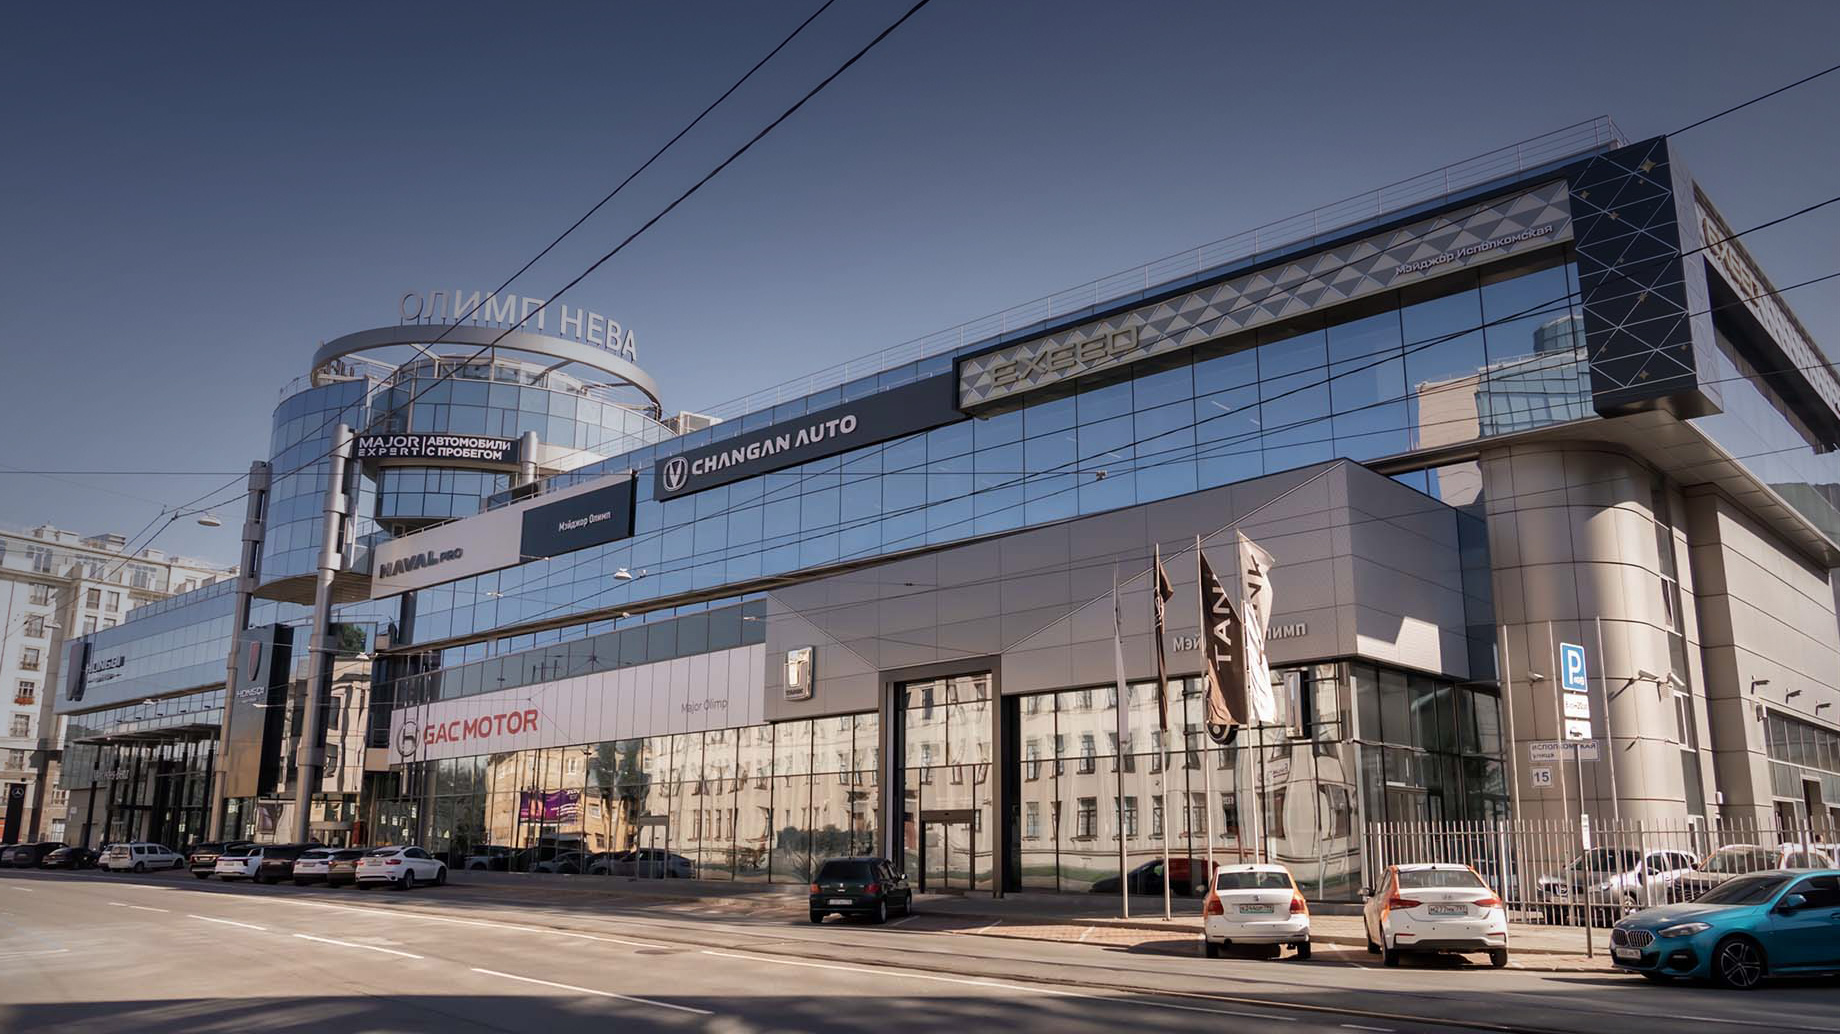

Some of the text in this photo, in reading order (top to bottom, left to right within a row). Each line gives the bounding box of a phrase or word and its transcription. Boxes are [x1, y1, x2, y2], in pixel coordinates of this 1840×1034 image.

[1395, 225, 1553, 275] Мэйджор Исполкомская
[400, 289, 638, 362] ОЛИМП НЕВА
[359, 436, 420, 448] MAJOR
[427, 436, 511, 451] АВТОМОБИЛИ
[692, 415, 857, 475] CHANGAN AUTO
[358, 448, 420, 457] EXPERT
[437, 448, 503, 460] ПРОБЕГОМ
[558, 510, 612, 532] Мэйджор Олимп
[440, 548, 464, 564] PRO
[1212, 574, 1232, 671] TAN
[681, 698, 729, 714] Major Olimp
[423, 709, 539, 745] GAC MOTOR
[1534, 771, 1549, 782] 15
